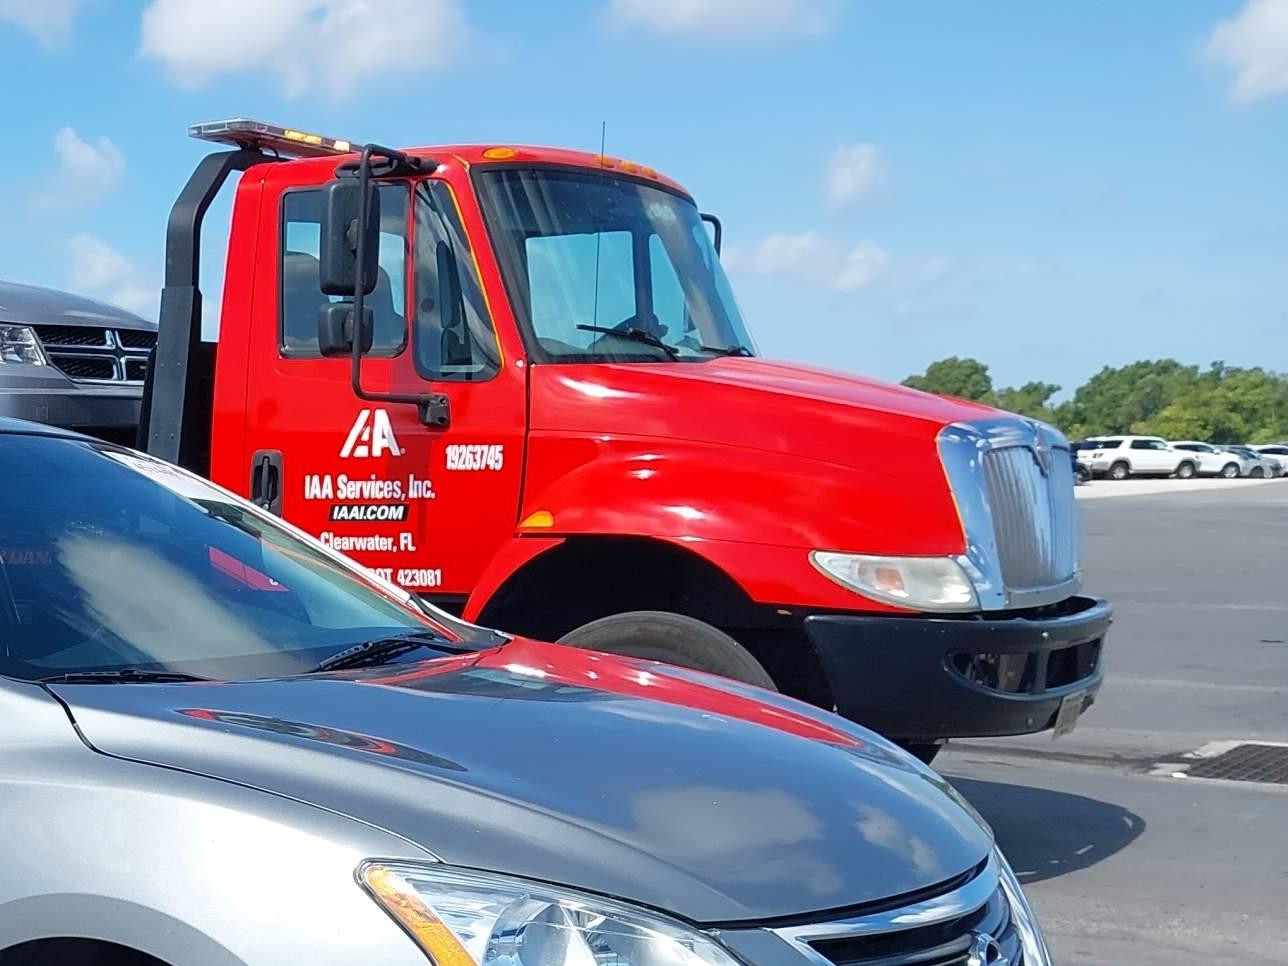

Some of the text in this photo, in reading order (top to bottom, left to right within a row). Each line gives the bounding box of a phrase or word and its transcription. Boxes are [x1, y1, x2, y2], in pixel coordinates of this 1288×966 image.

[445, 444, 504, 471] 19263745
[304, 473, 435, 501] IAA Services, Inc.
[332, 505, 405, 521] IAAI.COM
[320, 531, 416, 553] Clearwater, FL
[396, 568, 442, 587] 423081
